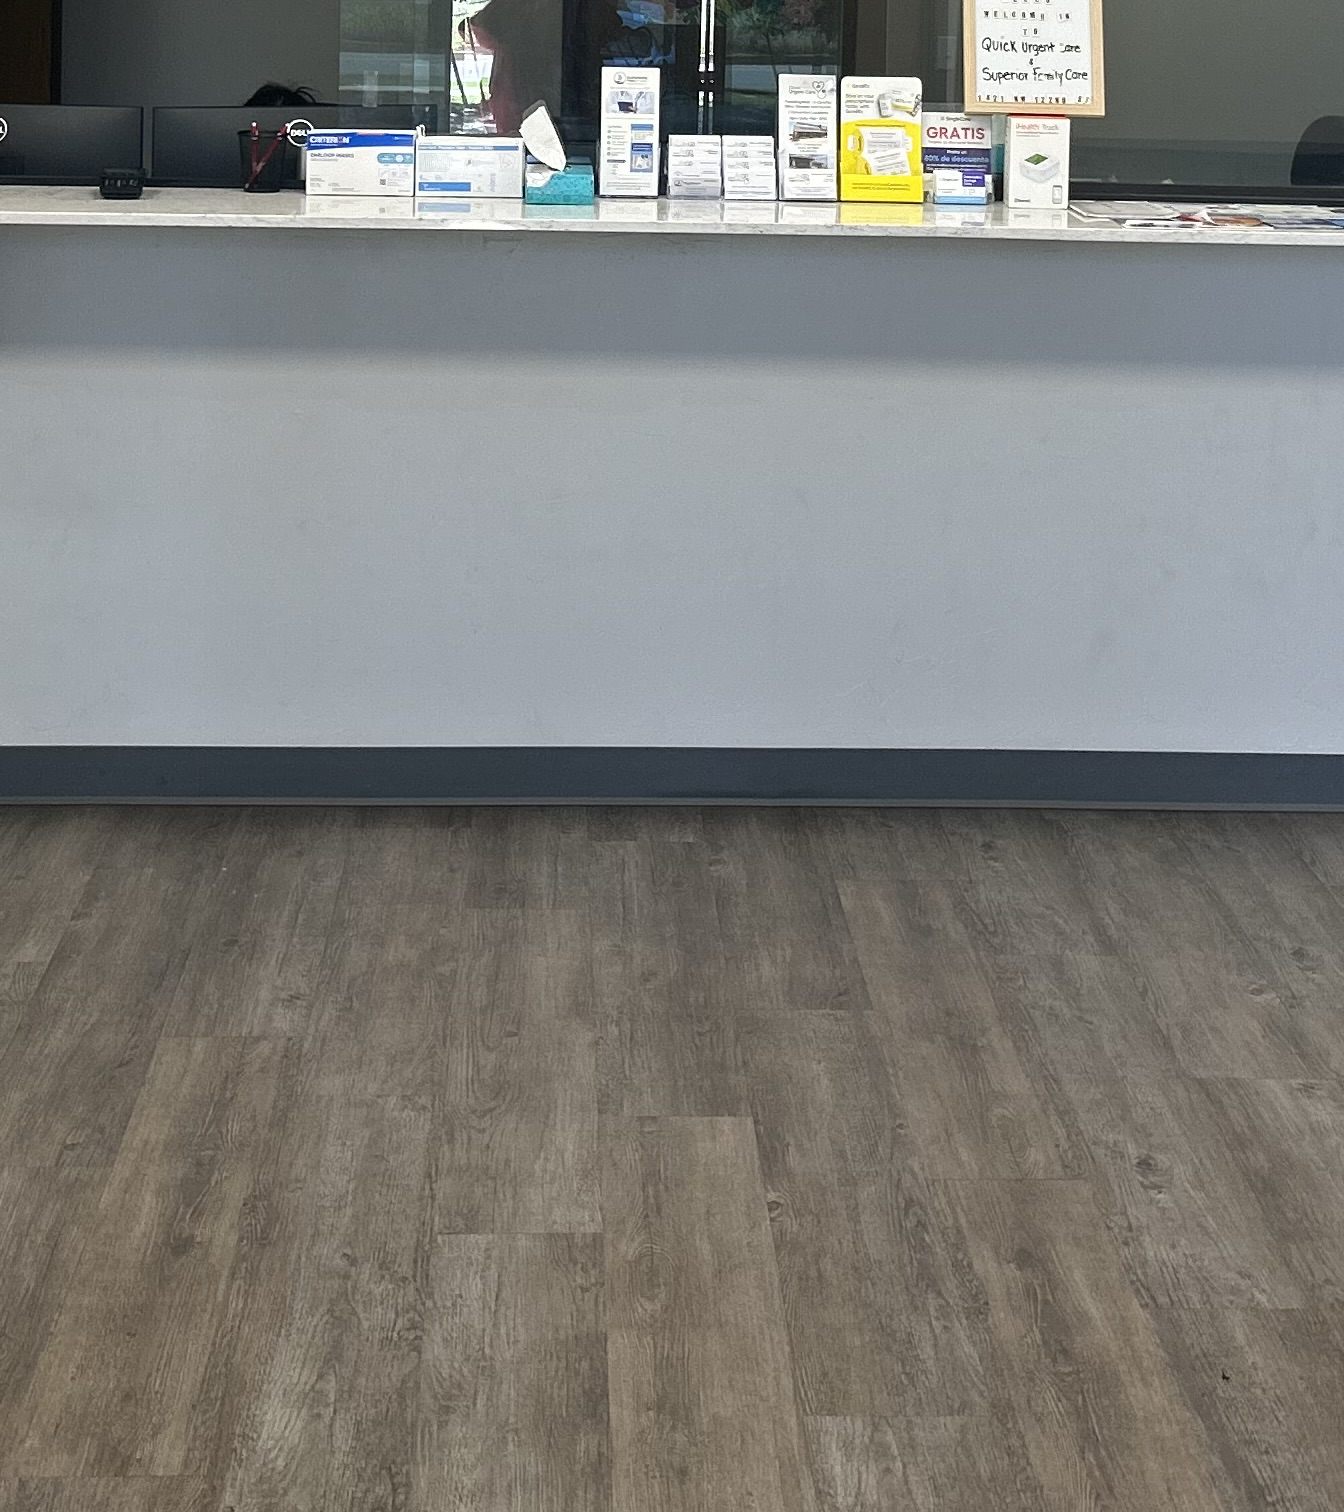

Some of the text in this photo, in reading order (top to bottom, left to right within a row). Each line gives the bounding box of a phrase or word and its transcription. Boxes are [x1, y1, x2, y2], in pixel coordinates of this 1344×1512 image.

[1021, 41, 1056, 56] Urgent
[982, 67, 1028, 84] Superior
[1065, 69, 1088, 81] Care
[926, 126, 985, 140] GRATIS
